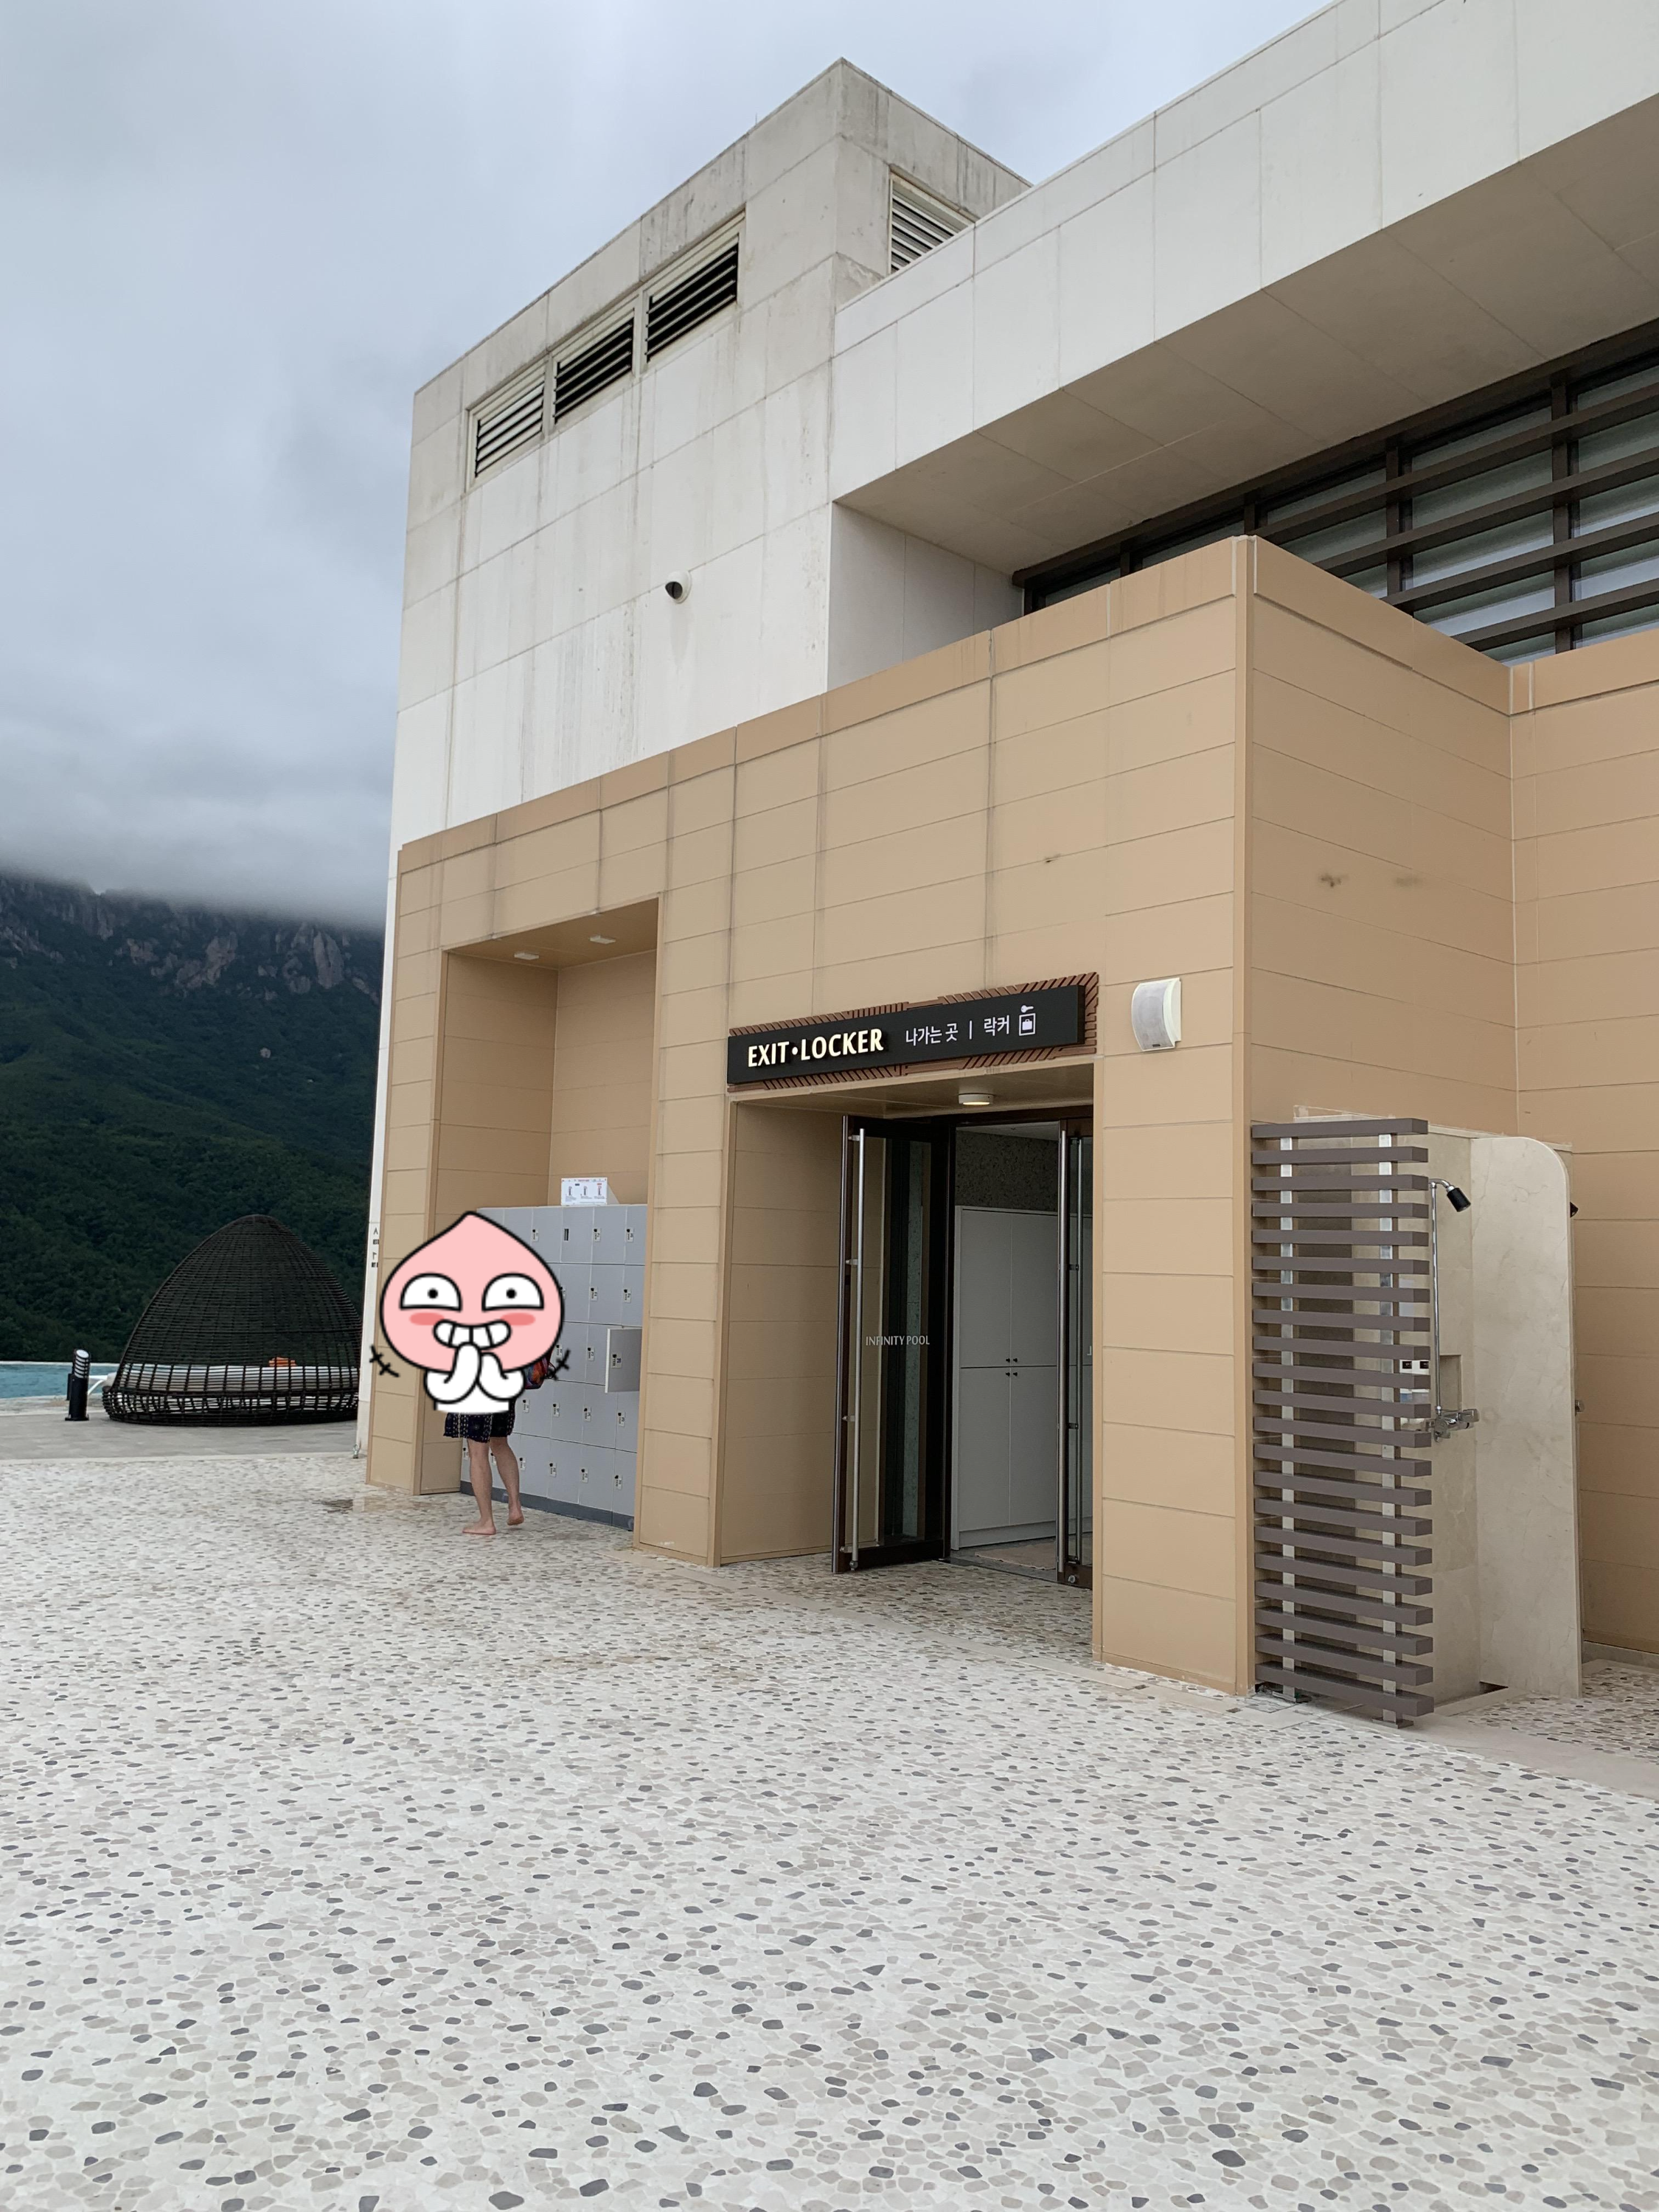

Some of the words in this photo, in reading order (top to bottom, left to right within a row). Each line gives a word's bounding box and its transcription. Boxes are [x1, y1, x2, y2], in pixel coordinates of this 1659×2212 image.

[905, 1026, 943, 1046] 나가는
[945, 1023, 959, 1042] 곳
[984, 1015, 1010, 1037] 락커
[865, 1335, 905, 1346] INFINITY
[906, 1335, 931, 1346] POOL
